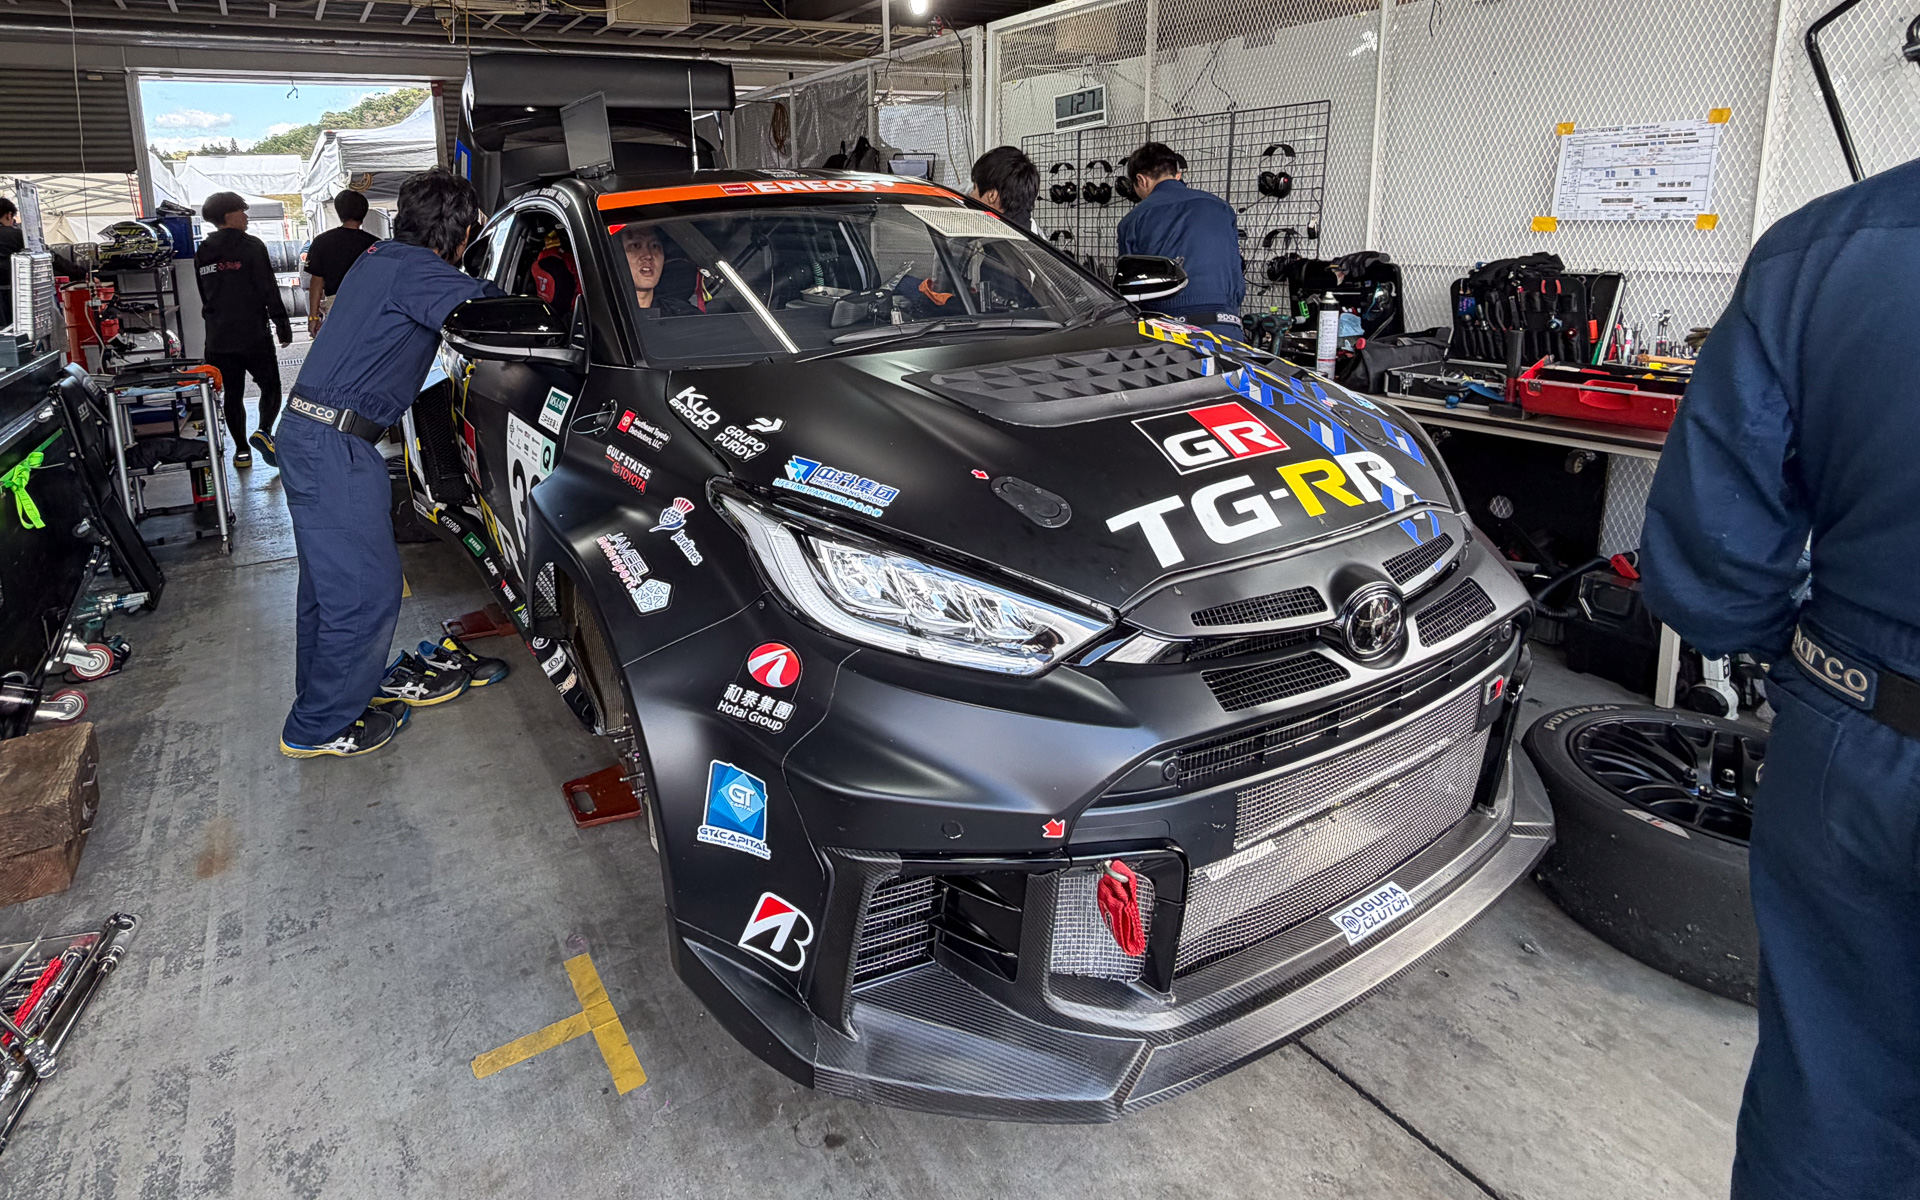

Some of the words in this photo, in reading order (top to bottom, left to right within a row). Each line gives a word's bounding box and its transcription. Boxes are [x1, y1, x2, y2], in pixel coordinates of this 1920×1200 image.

[753, 180, 877, 193] ENEOS
[291, 397, 335, 419] sparco
[668, 397, 710, 430] GROUP
[675, 386, 721, 425] KUO
[633, 417, 655, 434] Southeast
[653, 427, 669, 442] Toyota
[651, 438, 663, 449] LLC
[724, 425, 766, 452] GRUPO
[1163, 419, 1282, 467] GR
[543, 445, 552, 472] Q
[713, 432, 757, 460] PURDY
[606, 444, 624, 462] GULF
[623, 455, 651, 480] STATES
[619, 465, 647, 493] TOYOTA
[773, 478, 810, 494] LIFETIME
[807, 486, 847, 506] PARTNER
[809, 477, 861, 499] ZHONGSHENG
[859, 494, 890, 507] GROUP
[816, 466, 901, 502] 中升集团
[1105, 451, 1416, 569] TG-RR
[606, 532, 649, 584] JAMEEL
[671, 529, 703, 566] Jardines
[717, 699, 749, 718] Hotai
[748, 711, 783, 731] Group
[723, 684, 794, 720] 和泰集團
[1543, 704, 1621, 731] POTENZA
[728, 783, 756, 808] GT
[719, 830, 769, 853] CAPITAL
[1351, 886, 1402, 918] OGURA
[1363, 893, 1410, 930] CLUTCH
